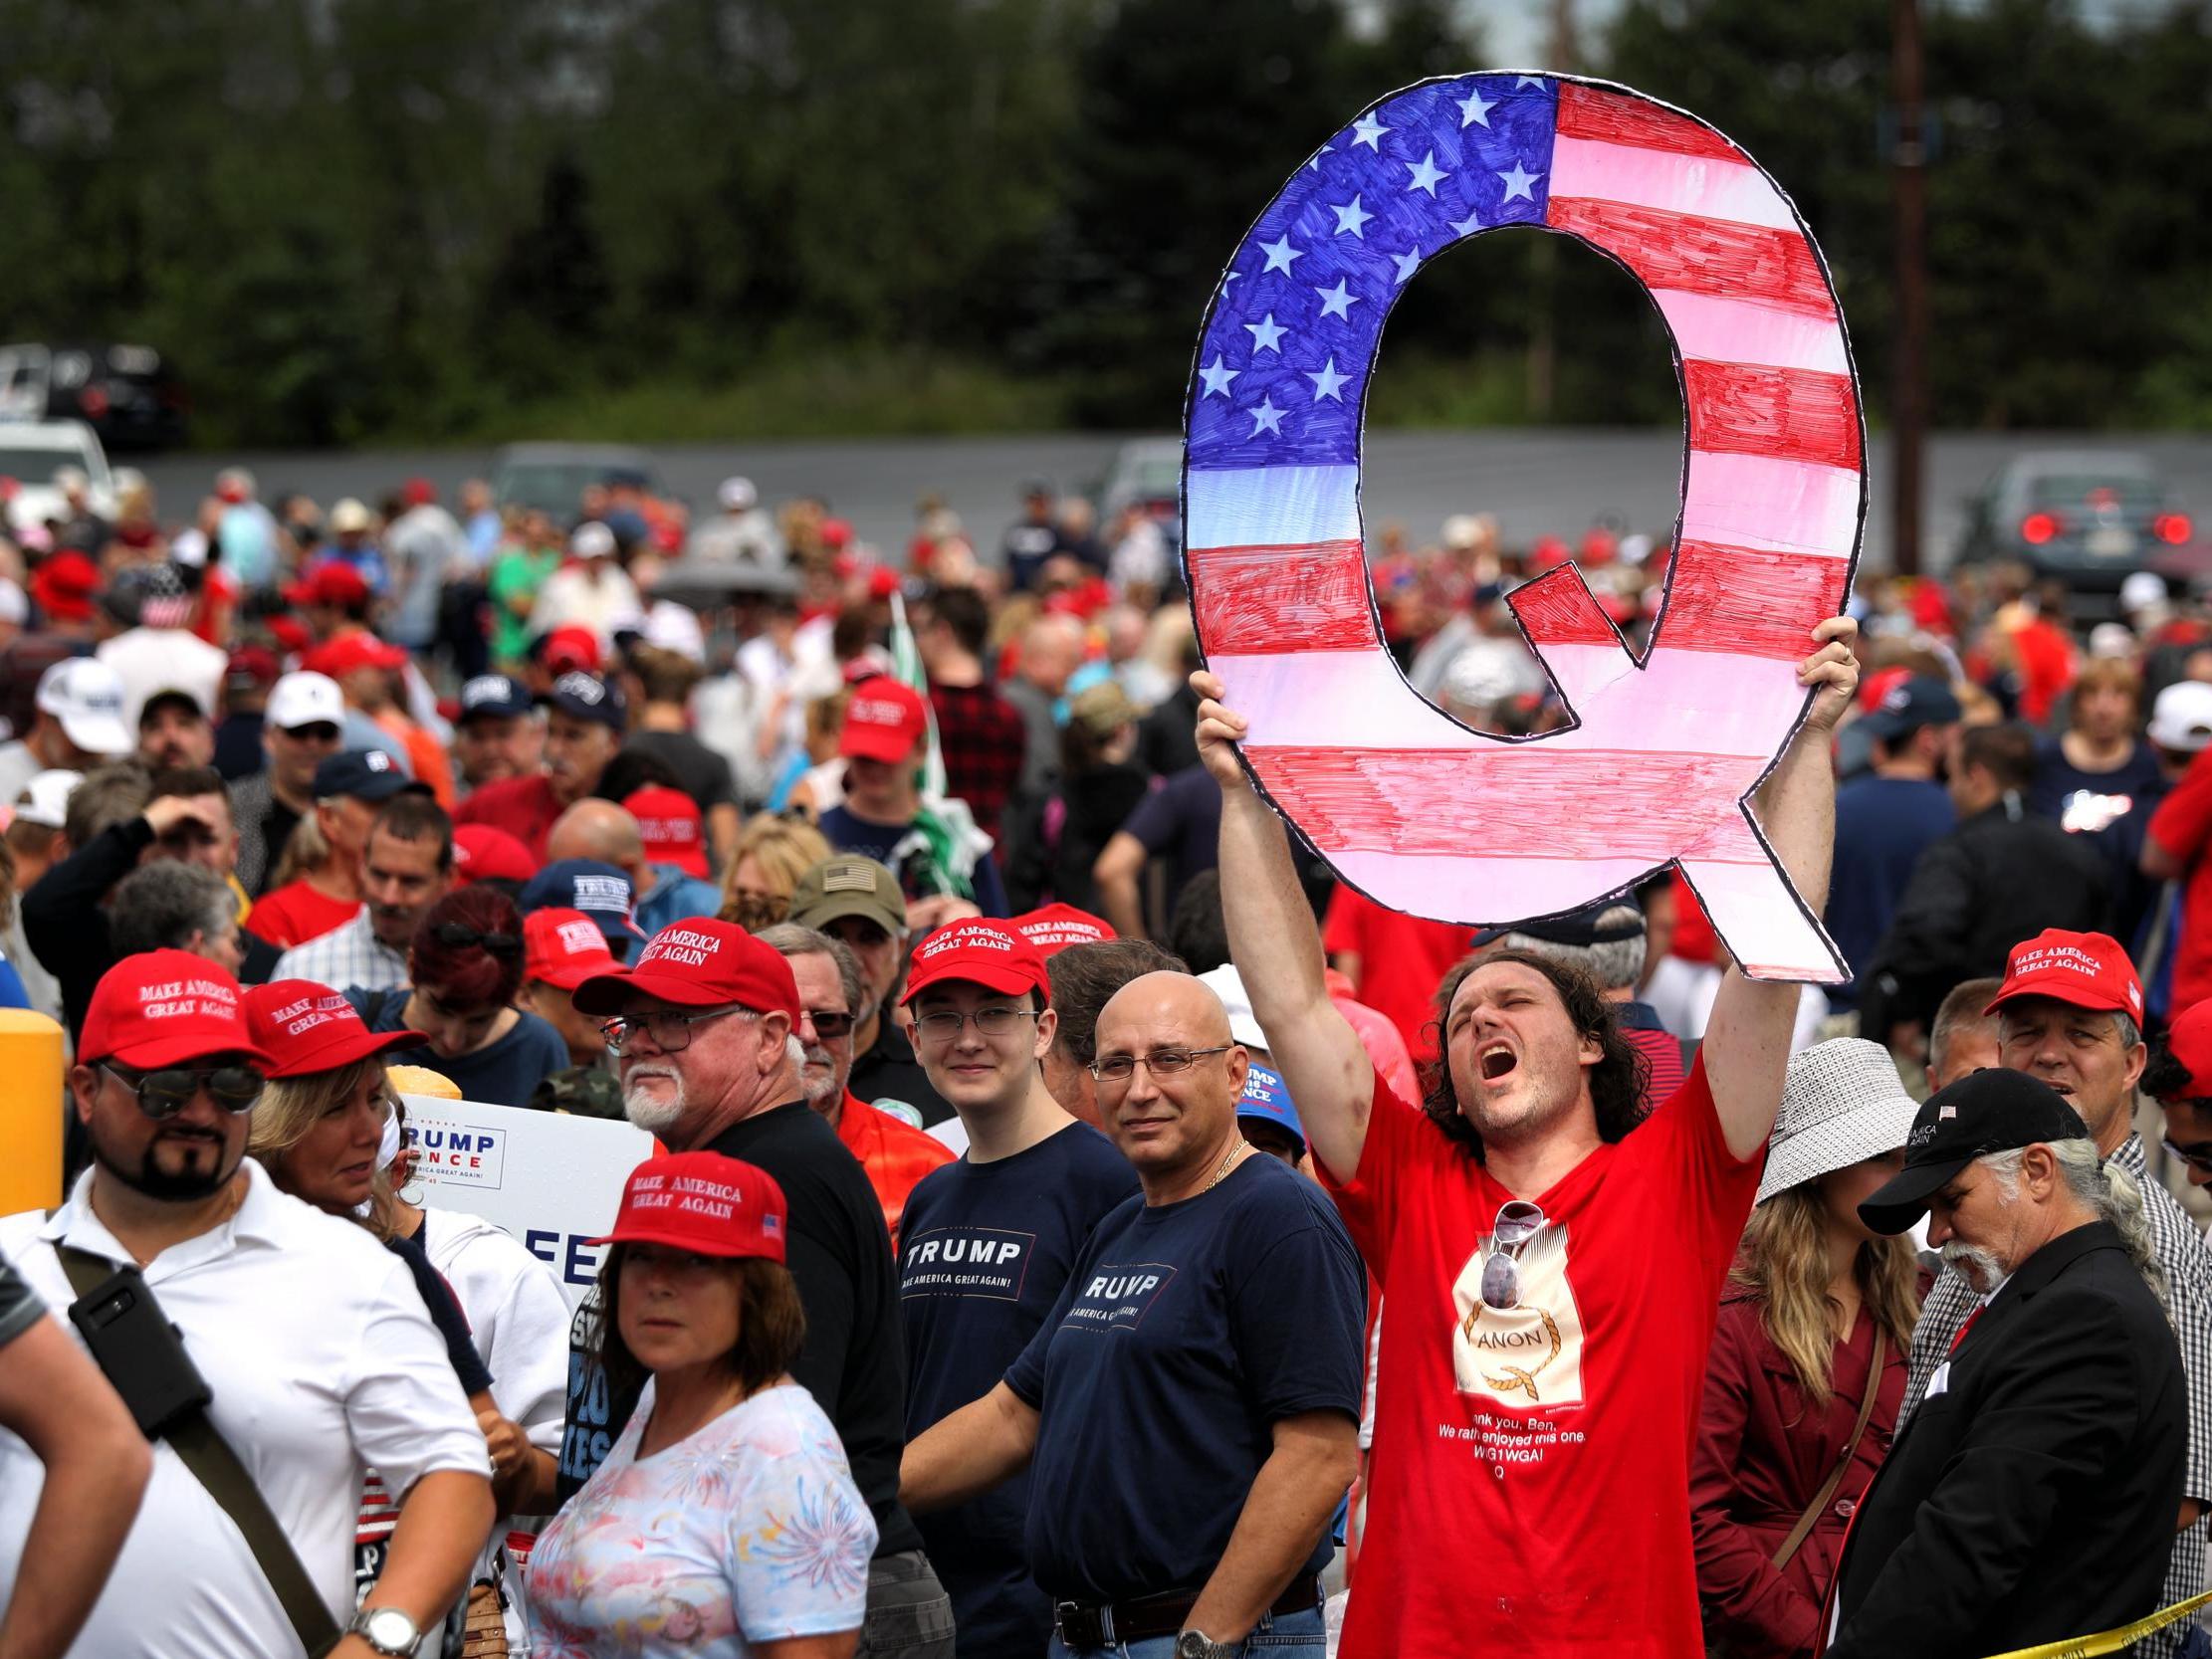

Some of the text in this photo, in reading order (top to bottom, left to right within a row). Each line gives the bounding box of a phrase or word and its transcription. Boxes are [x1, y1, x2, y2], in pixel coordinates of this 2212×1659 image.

[1180, 69, 1870, 983] Q
[957, 926, 1015, 944] AMERICA
[1052, 921, 1103, 938] AMERICA
[660, 930, 721, 952] AMERICA
[924, 937, 1011, 957] GREAT AGAIN
[660, 944, 708, 966] AGAIN
[2046, 946, 2102, 970] AMERICA
[2015, 958, 2096, 977] GREAT AGAIN
[139, 981, 183, 1002] MAKE
[144, 1000, 196, 1018] GREAT
[406, 1128, 495, 1152] RUMP
[632, 1175, 742, 1202] MAKE AMERICA
[632, 1194, 733, 1219] GREAT AGAIN
[907, 1238, 1021, 1269] TRUMP
[914, 1274, 953, 1285] AMERICA
[955, 1275, 980, 1285] GREAT
[980, 1275, 1011, 1288] AGAIN!
[1074, 1308, 1106, 1321] AMERICA
[1477, 1330, 1543, 1348] ANON
[1496, 1417, 1522, 1431] you,
[1527, 1417, 1557, 1432] Ben.
[1438, 1423, 1455, 1438] We
[1481, 1431, 1532, 1447] enjoyed
[1560, 1430, 1586, 1442] one.
[1494, 1465, 1504, 1480] Q
